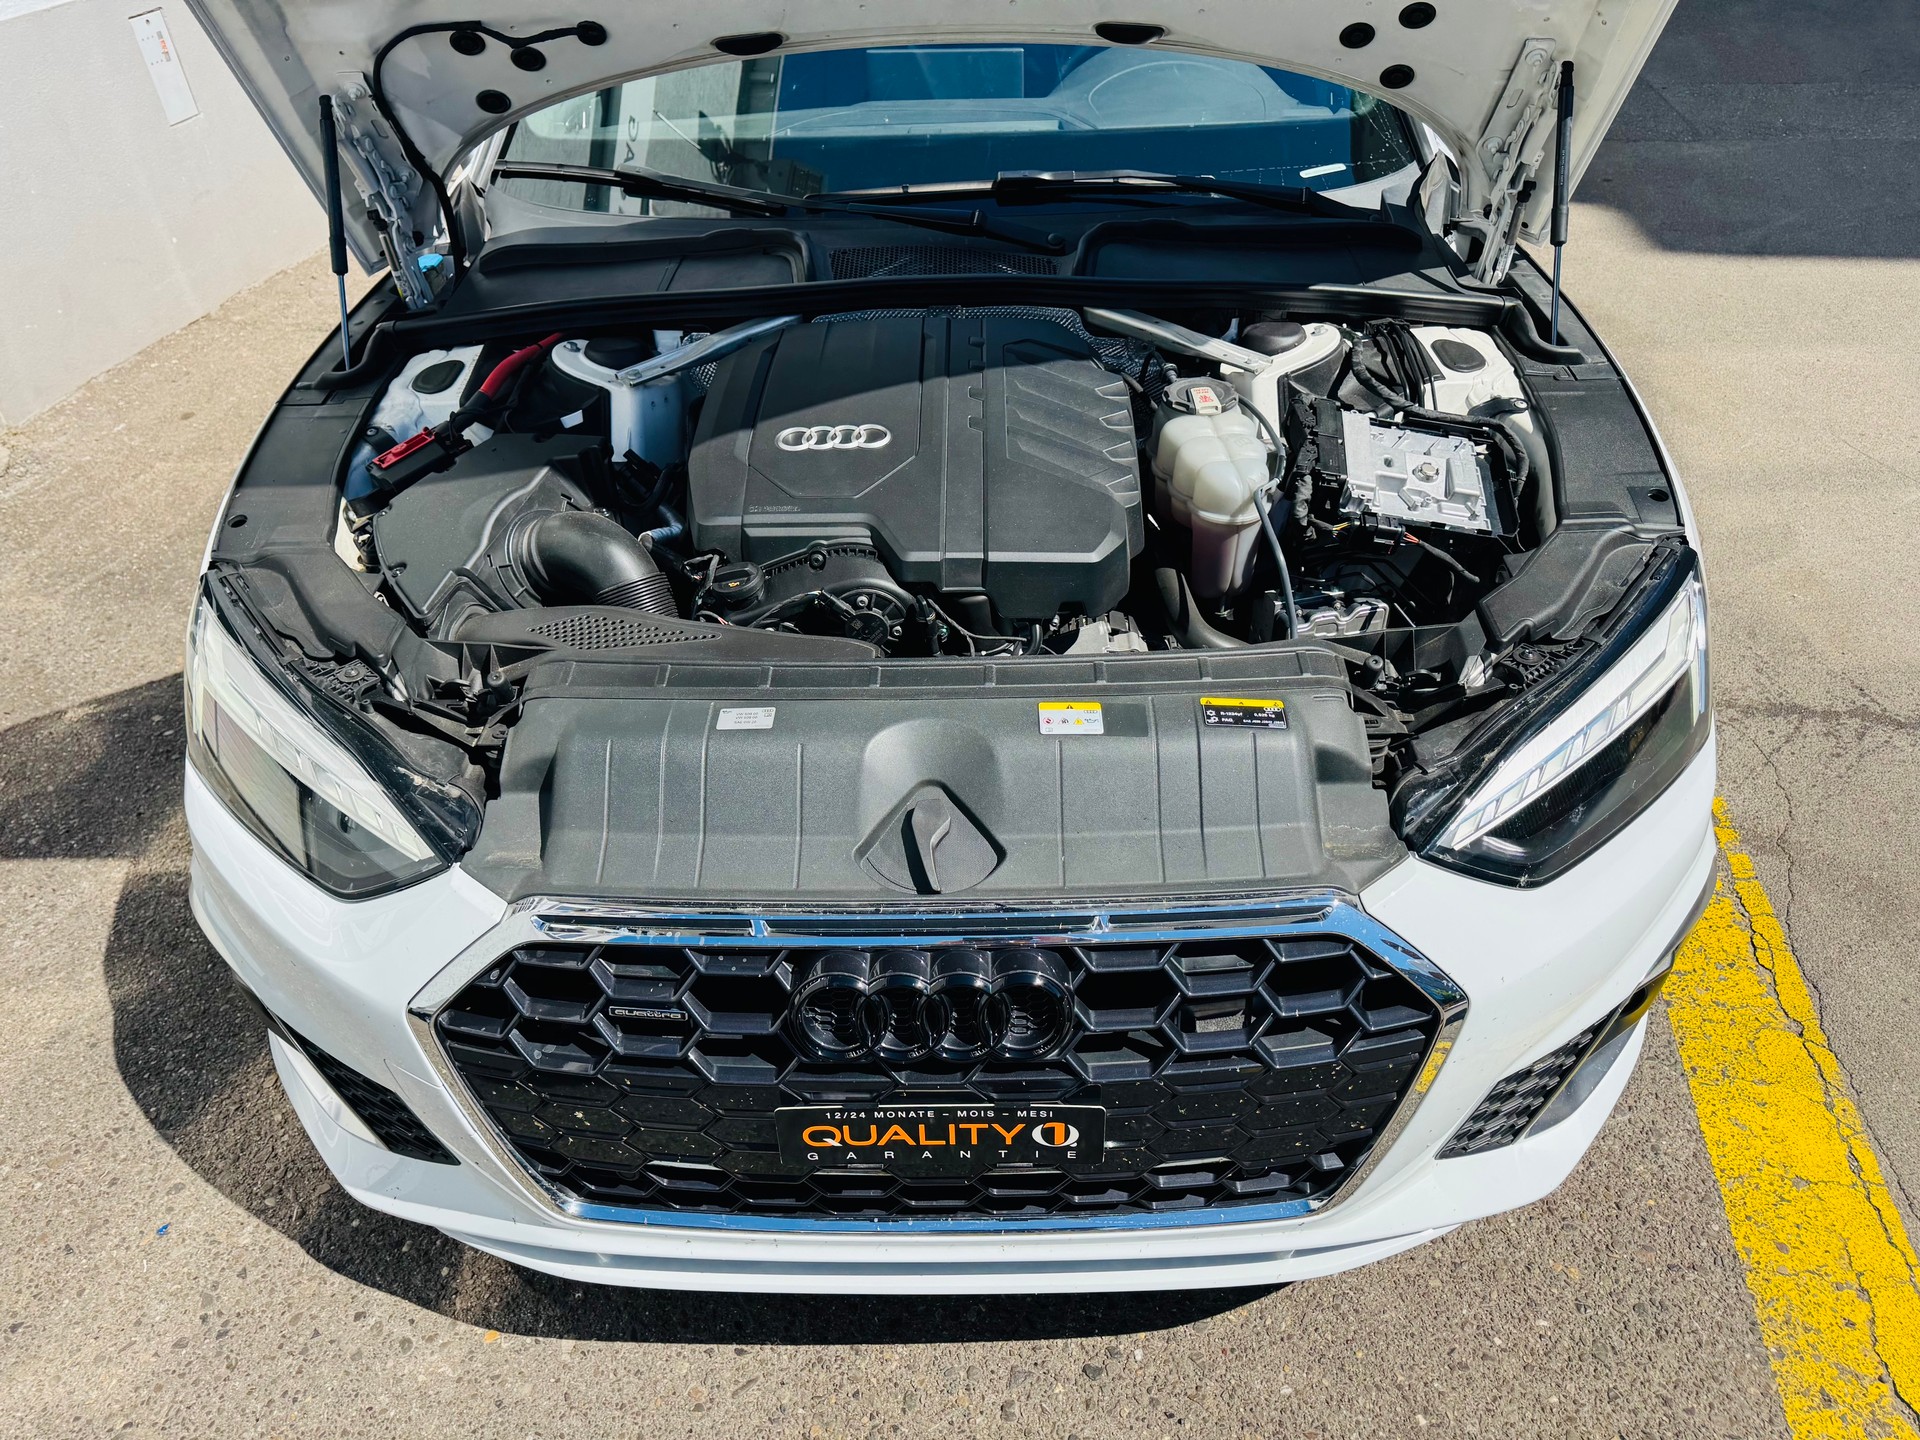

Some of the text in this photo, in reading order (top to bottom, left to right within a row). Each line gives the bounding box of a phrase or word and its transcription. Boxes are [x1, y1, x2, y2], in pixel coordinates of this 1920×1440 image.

[614, 1009, 681, 1018] quattro
[825, 1111, 866, 1119] 12/24
[874, 1110, 935, 1118] MONATE
[957, 1110, 995, 1118] MOIS
[1017, 1110, 1053, 1118] MESI
[802, 1123, 1026, 1147] QUALITY
[807, 1150, 1077, 1161] GARANTIE
